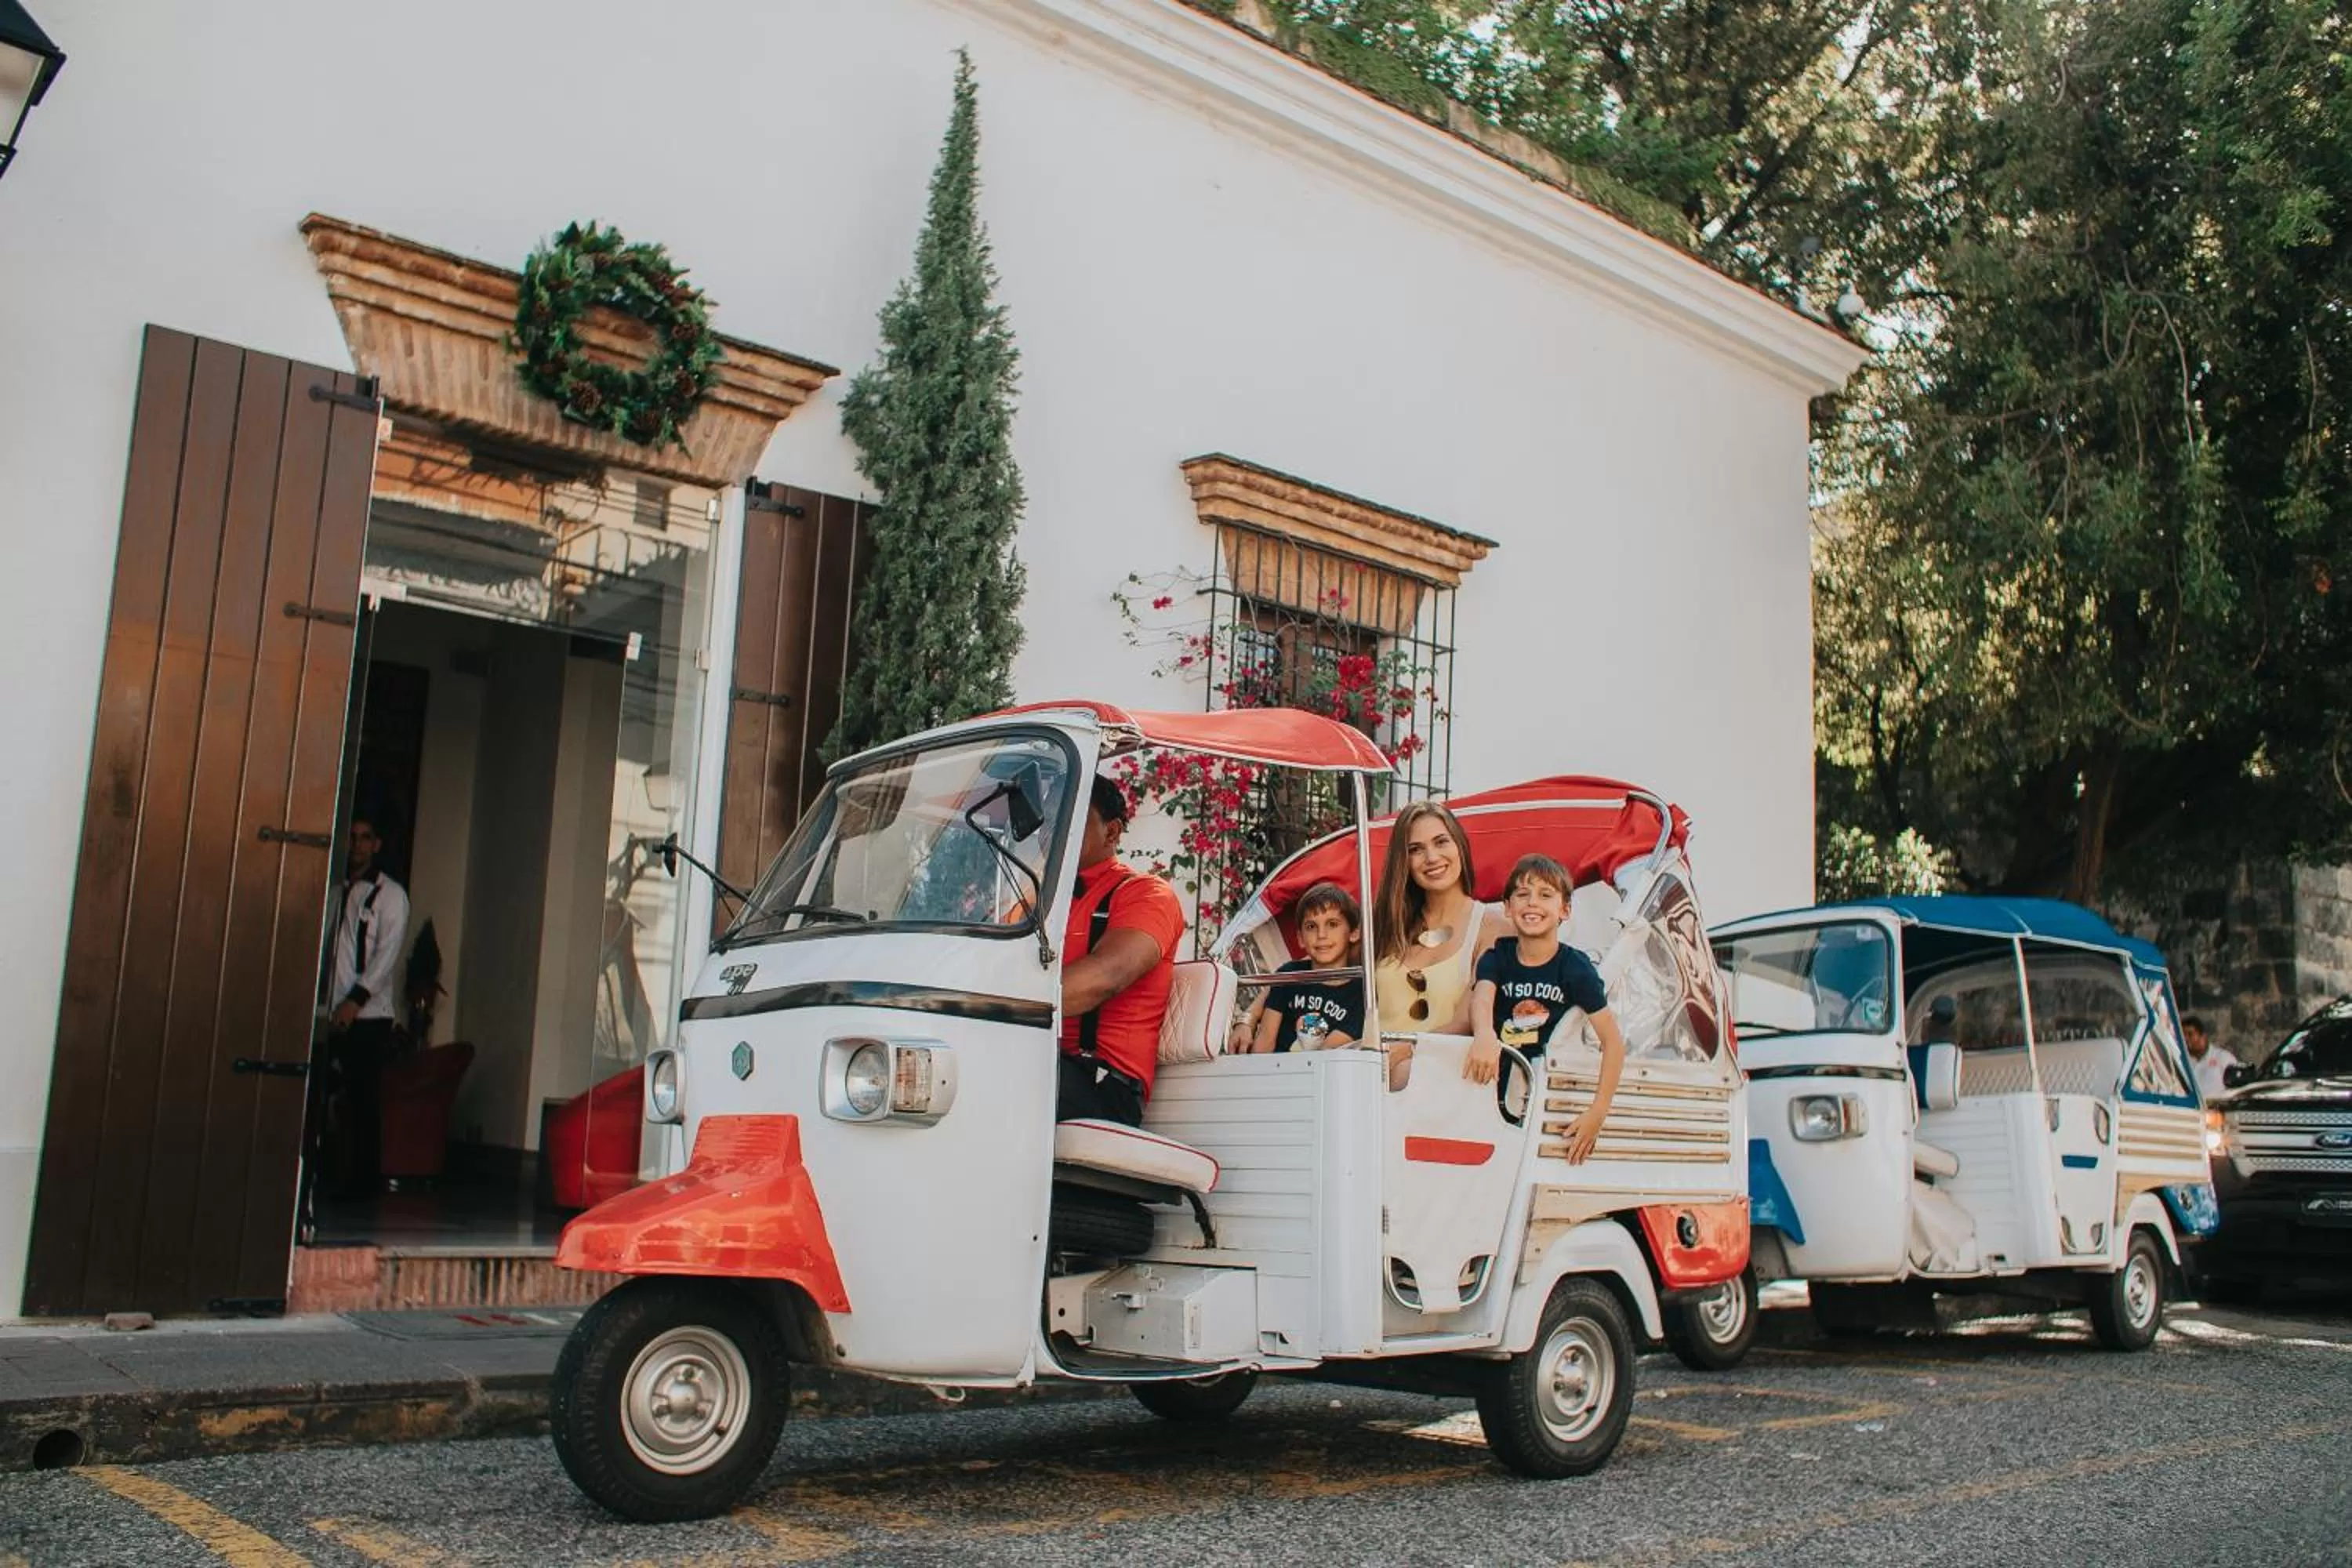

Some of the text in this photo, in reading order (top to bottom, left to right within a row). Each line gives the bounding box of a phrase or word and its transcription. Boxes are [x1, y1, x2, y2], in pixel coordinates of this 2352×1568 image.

[1515, 982, 1533, 998] SO
[1308, 995, 1323, 1011] SO
[1323, 1000, 1347, 1022] COO
